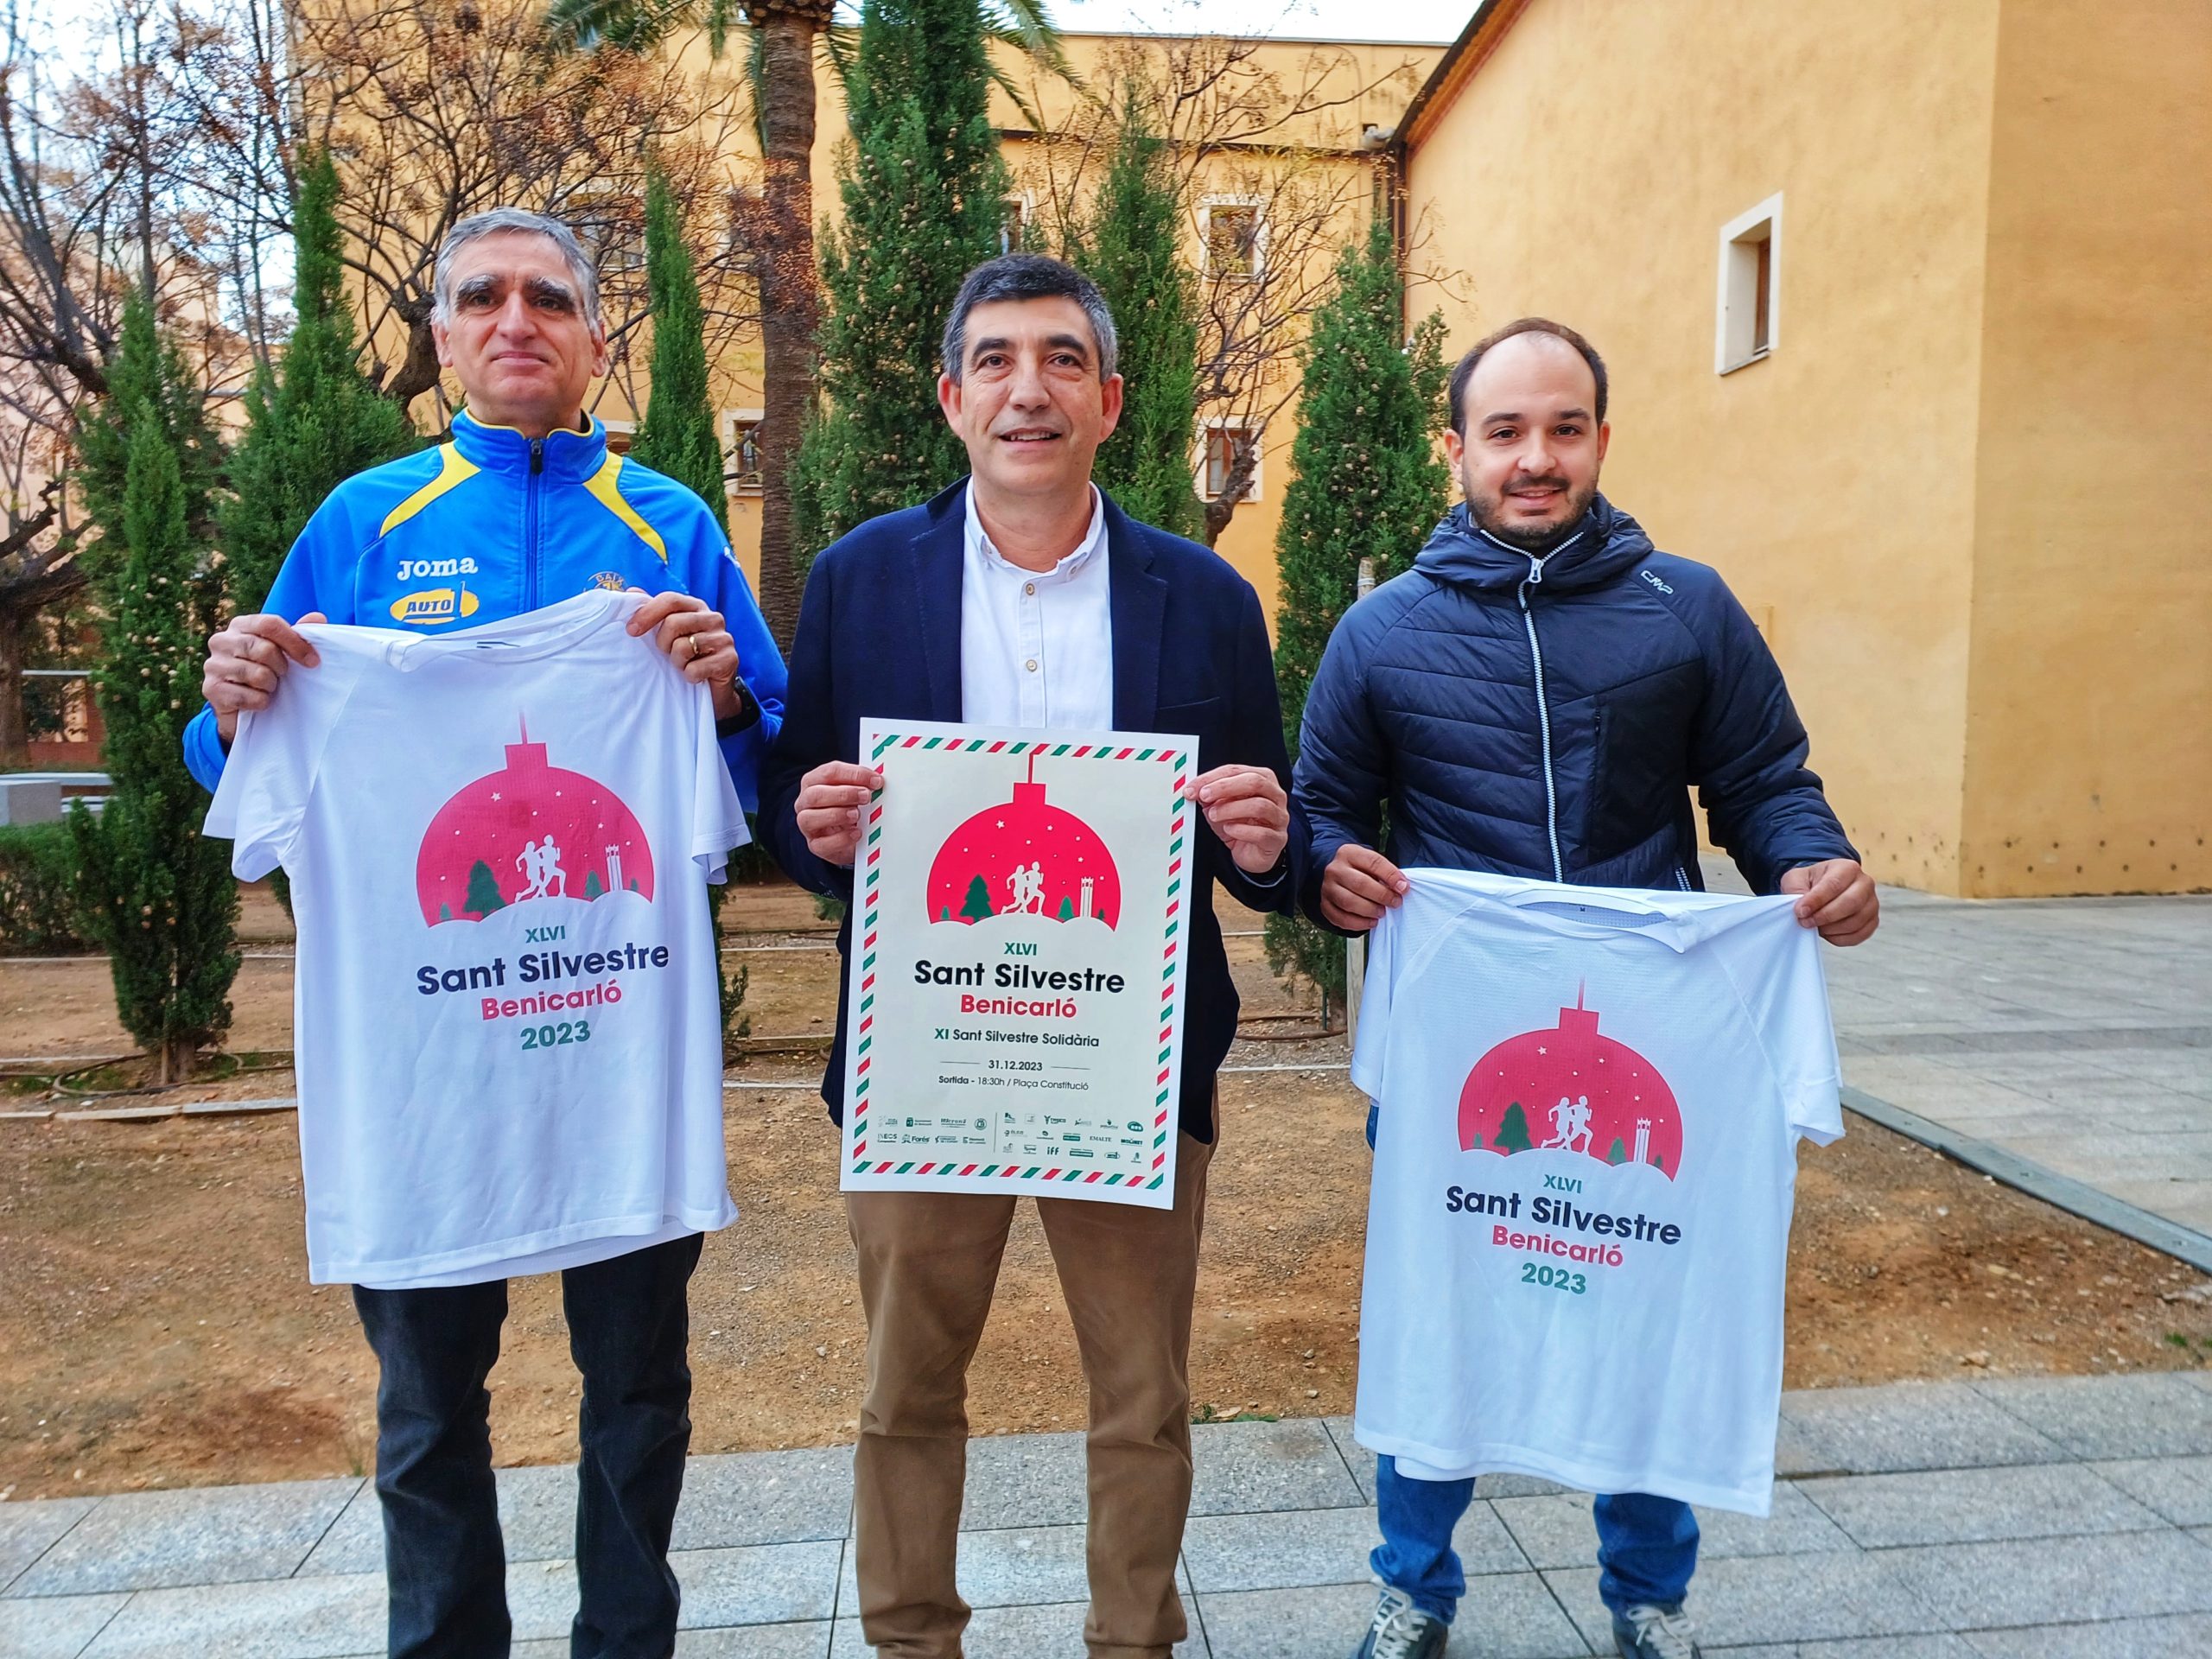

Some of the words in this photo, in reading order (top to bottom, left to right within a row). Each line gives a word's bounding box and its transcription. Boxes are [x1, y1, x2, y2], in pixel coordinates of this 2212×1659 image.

[397, 557, 479, 581] Joma
[1641, 570, 1674, 594] CMP
[406, 600, 451, 613] AUTO
[525, 925, 565, 944] XLVI
[1004, 942, 1038, 956] XLVI
[417, 957, 505, 995] Sant
[518, 942, 669, 982] Silvestre
[914, 960, 985, 986] Sant
[995, 963, 1124, 993] Silvestre
[481, 979, 621, 1020] Benicarló
[961, 995, 1077, 1017] Benicarló
[520, 1020, 590, 1050] 2023
[934, 1028, 949, 1039] XI
[953, 1029, 982, 1041] Sant
[985, 1031, 1038, 1044] Silvestre
[1042, 1033, 1099, 1047] Solidària
[988, 1060, 1043, 1071] 31.12.2023
[938, 1076, 969, 1084] Sortida
[978, 1077, 1005, 1086] 18:30h
[1014, 1078, 1038, 1088] Plaça
[1040, 1080, 1089, 1090] Constitució
[1543, 1174, 1581, 1193] XLVI
[1446, 1185, 1521, 1218] Sant
[1532, 1197, 1681, 1245] Silvestre
[1492, 1224, 1623, 1267] Benicarló
[1522, 1262, 1586, 1294] 2023
